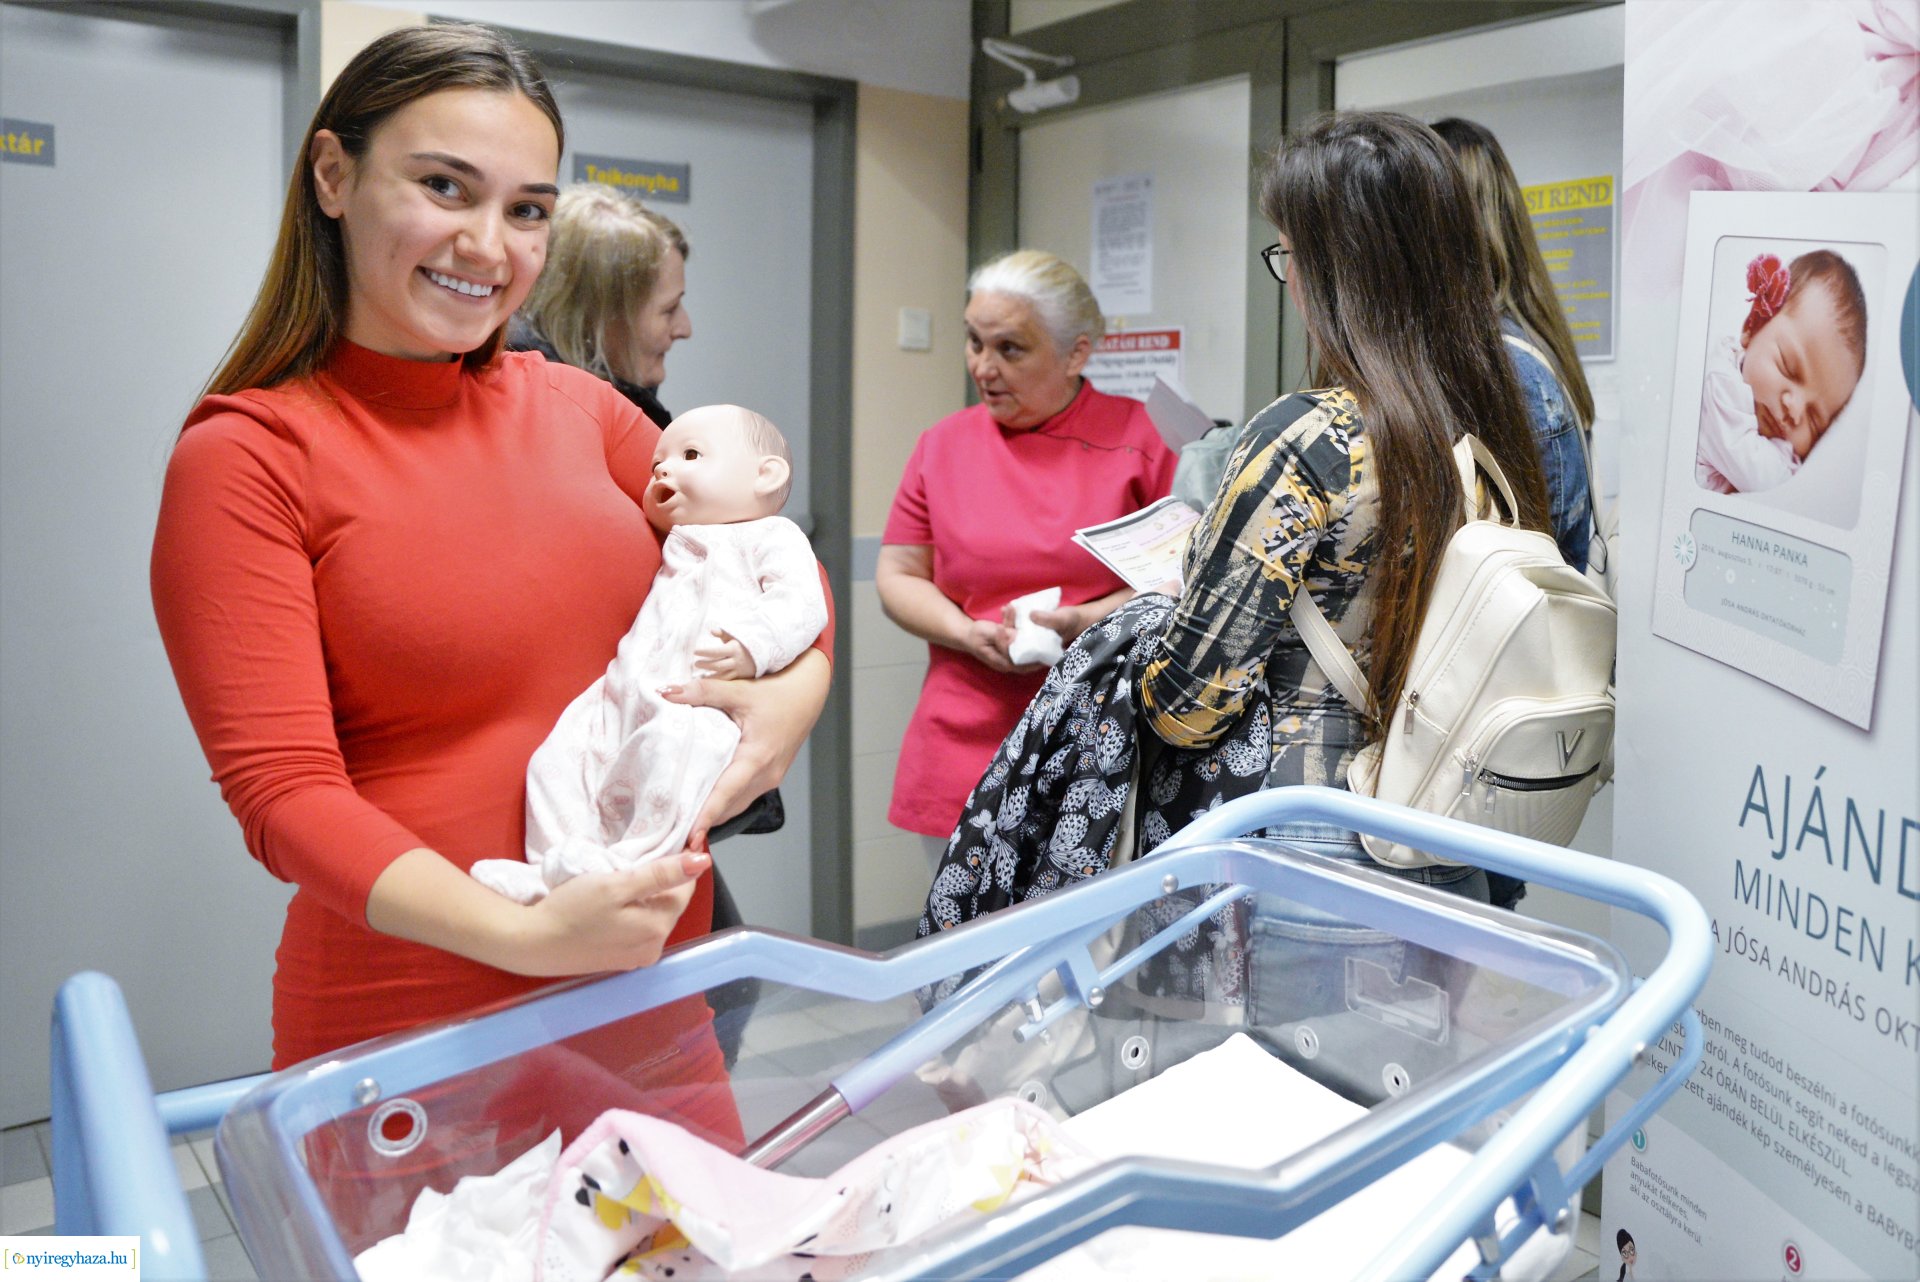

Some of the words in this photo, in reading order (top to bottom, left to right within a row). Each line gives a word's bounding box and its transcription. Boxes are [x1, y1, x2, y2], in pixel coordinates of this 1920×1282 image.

[1550, 181, 1611, 208] REND
[1731, 531, 1770, 554] HANNA
[1773, 543, 1808, 568] PANKA
[1734, 858, 1885, 973] MINDEN
[1711, 918, 1720, 944] A
[1725, 926, 1771, 972] JÓSA
[1778, 956, 1866, 1022] ANDRÁS
[1700, 1060, 1713, 1079] 24
[1716, 1068, 1747, 1103] ÓRÁN
[1750, 1093, 1785, 1131] BELÜL
[1724, 1027, 1747, 1055] meg
[1750, 1042, 1783, 1074] tudod
[1786, 1062, 1836, 1109] beszélni
[1839, 1101, 1847, 1116] a
[1733, 1057, 1740, 1070] A
[1743, 1061, 1792, 1109] fotósunk
[1795, 1100, 1825, 1130] segít
[1827, 1122, 1868, 1159] neked
[1871, 1151, 1880, 1167] a
[1630, 1170, 1659, 1197] anyukát
[1631, 1155, 1679, 1199] Babafotósunk
[1680, 1194, 1708, 1221] minden
[1707, 1092, 1748, 1130] ajándék
[1750, 1120, 1771, 1149] kép
[1774, 1140, 1851, 1206] személyesen
[1855, 1200, 1863, 1214] a
[1629, 1183, 1640, 1197] aki
[1641, 1192, 1650, 1203] az
[1650, 1198, 1682, 1229] osztályra
